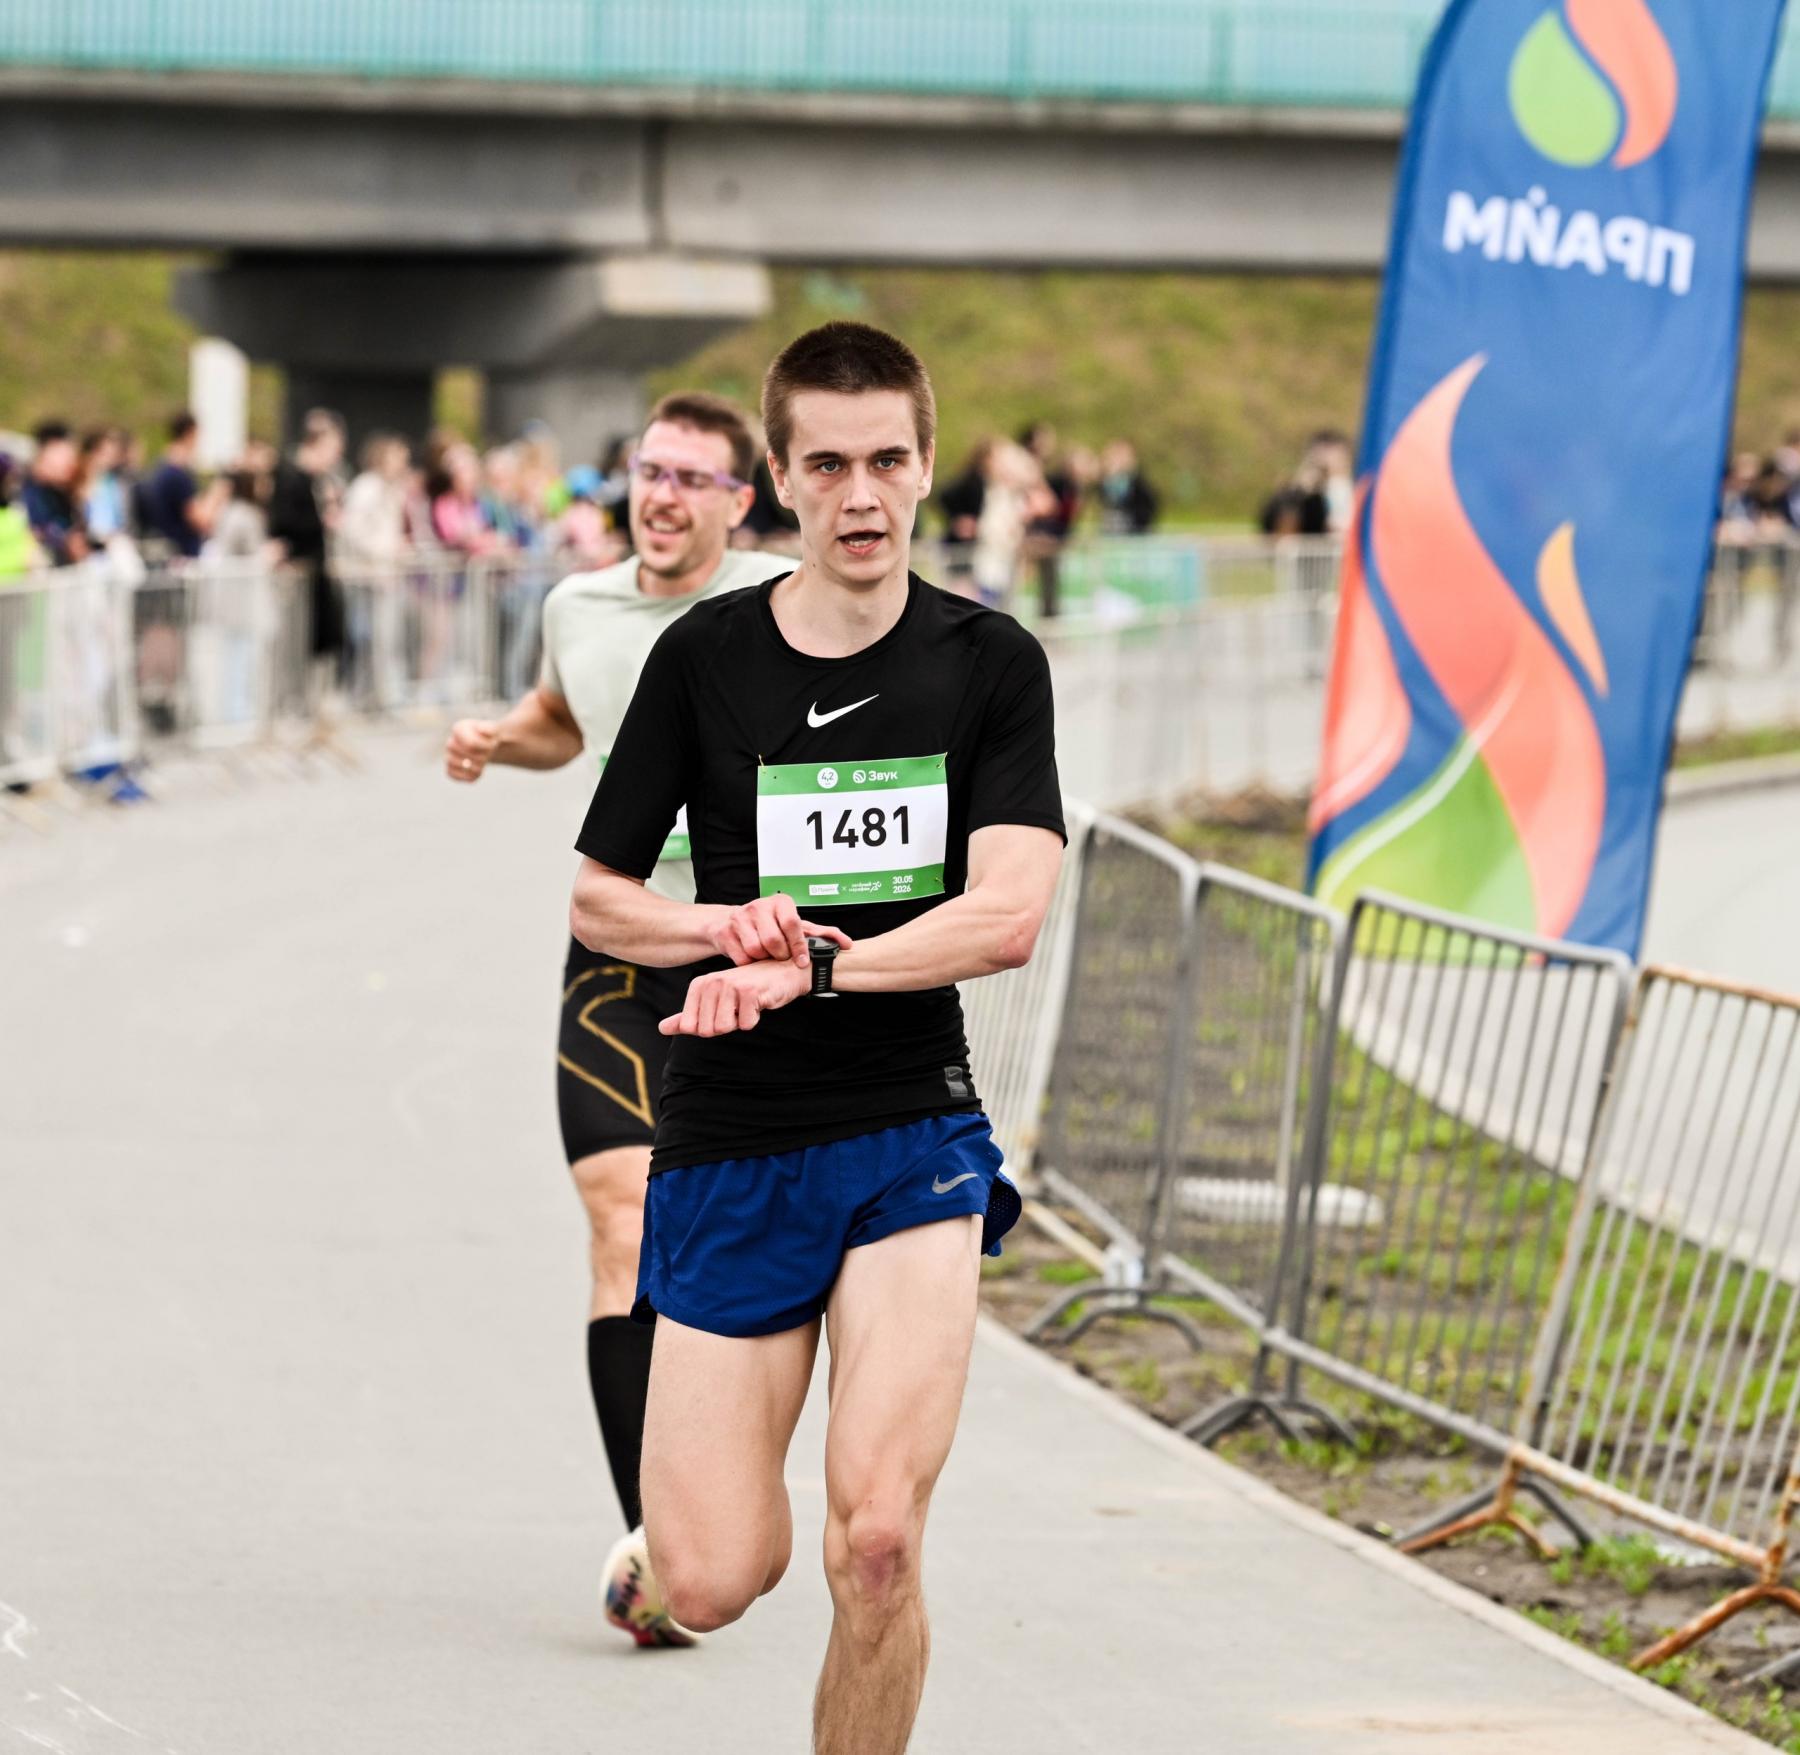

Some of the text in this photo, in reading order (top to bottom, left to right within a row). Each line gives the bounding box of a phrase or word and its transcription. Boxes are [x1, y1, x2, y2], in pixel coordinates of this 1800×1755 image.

[868, 770, 898, 782] Звук
[806, 805, 909, 850] 1481
[892, 875, 913, 884] 30.05
[892, 885, 912, 893] 2026
